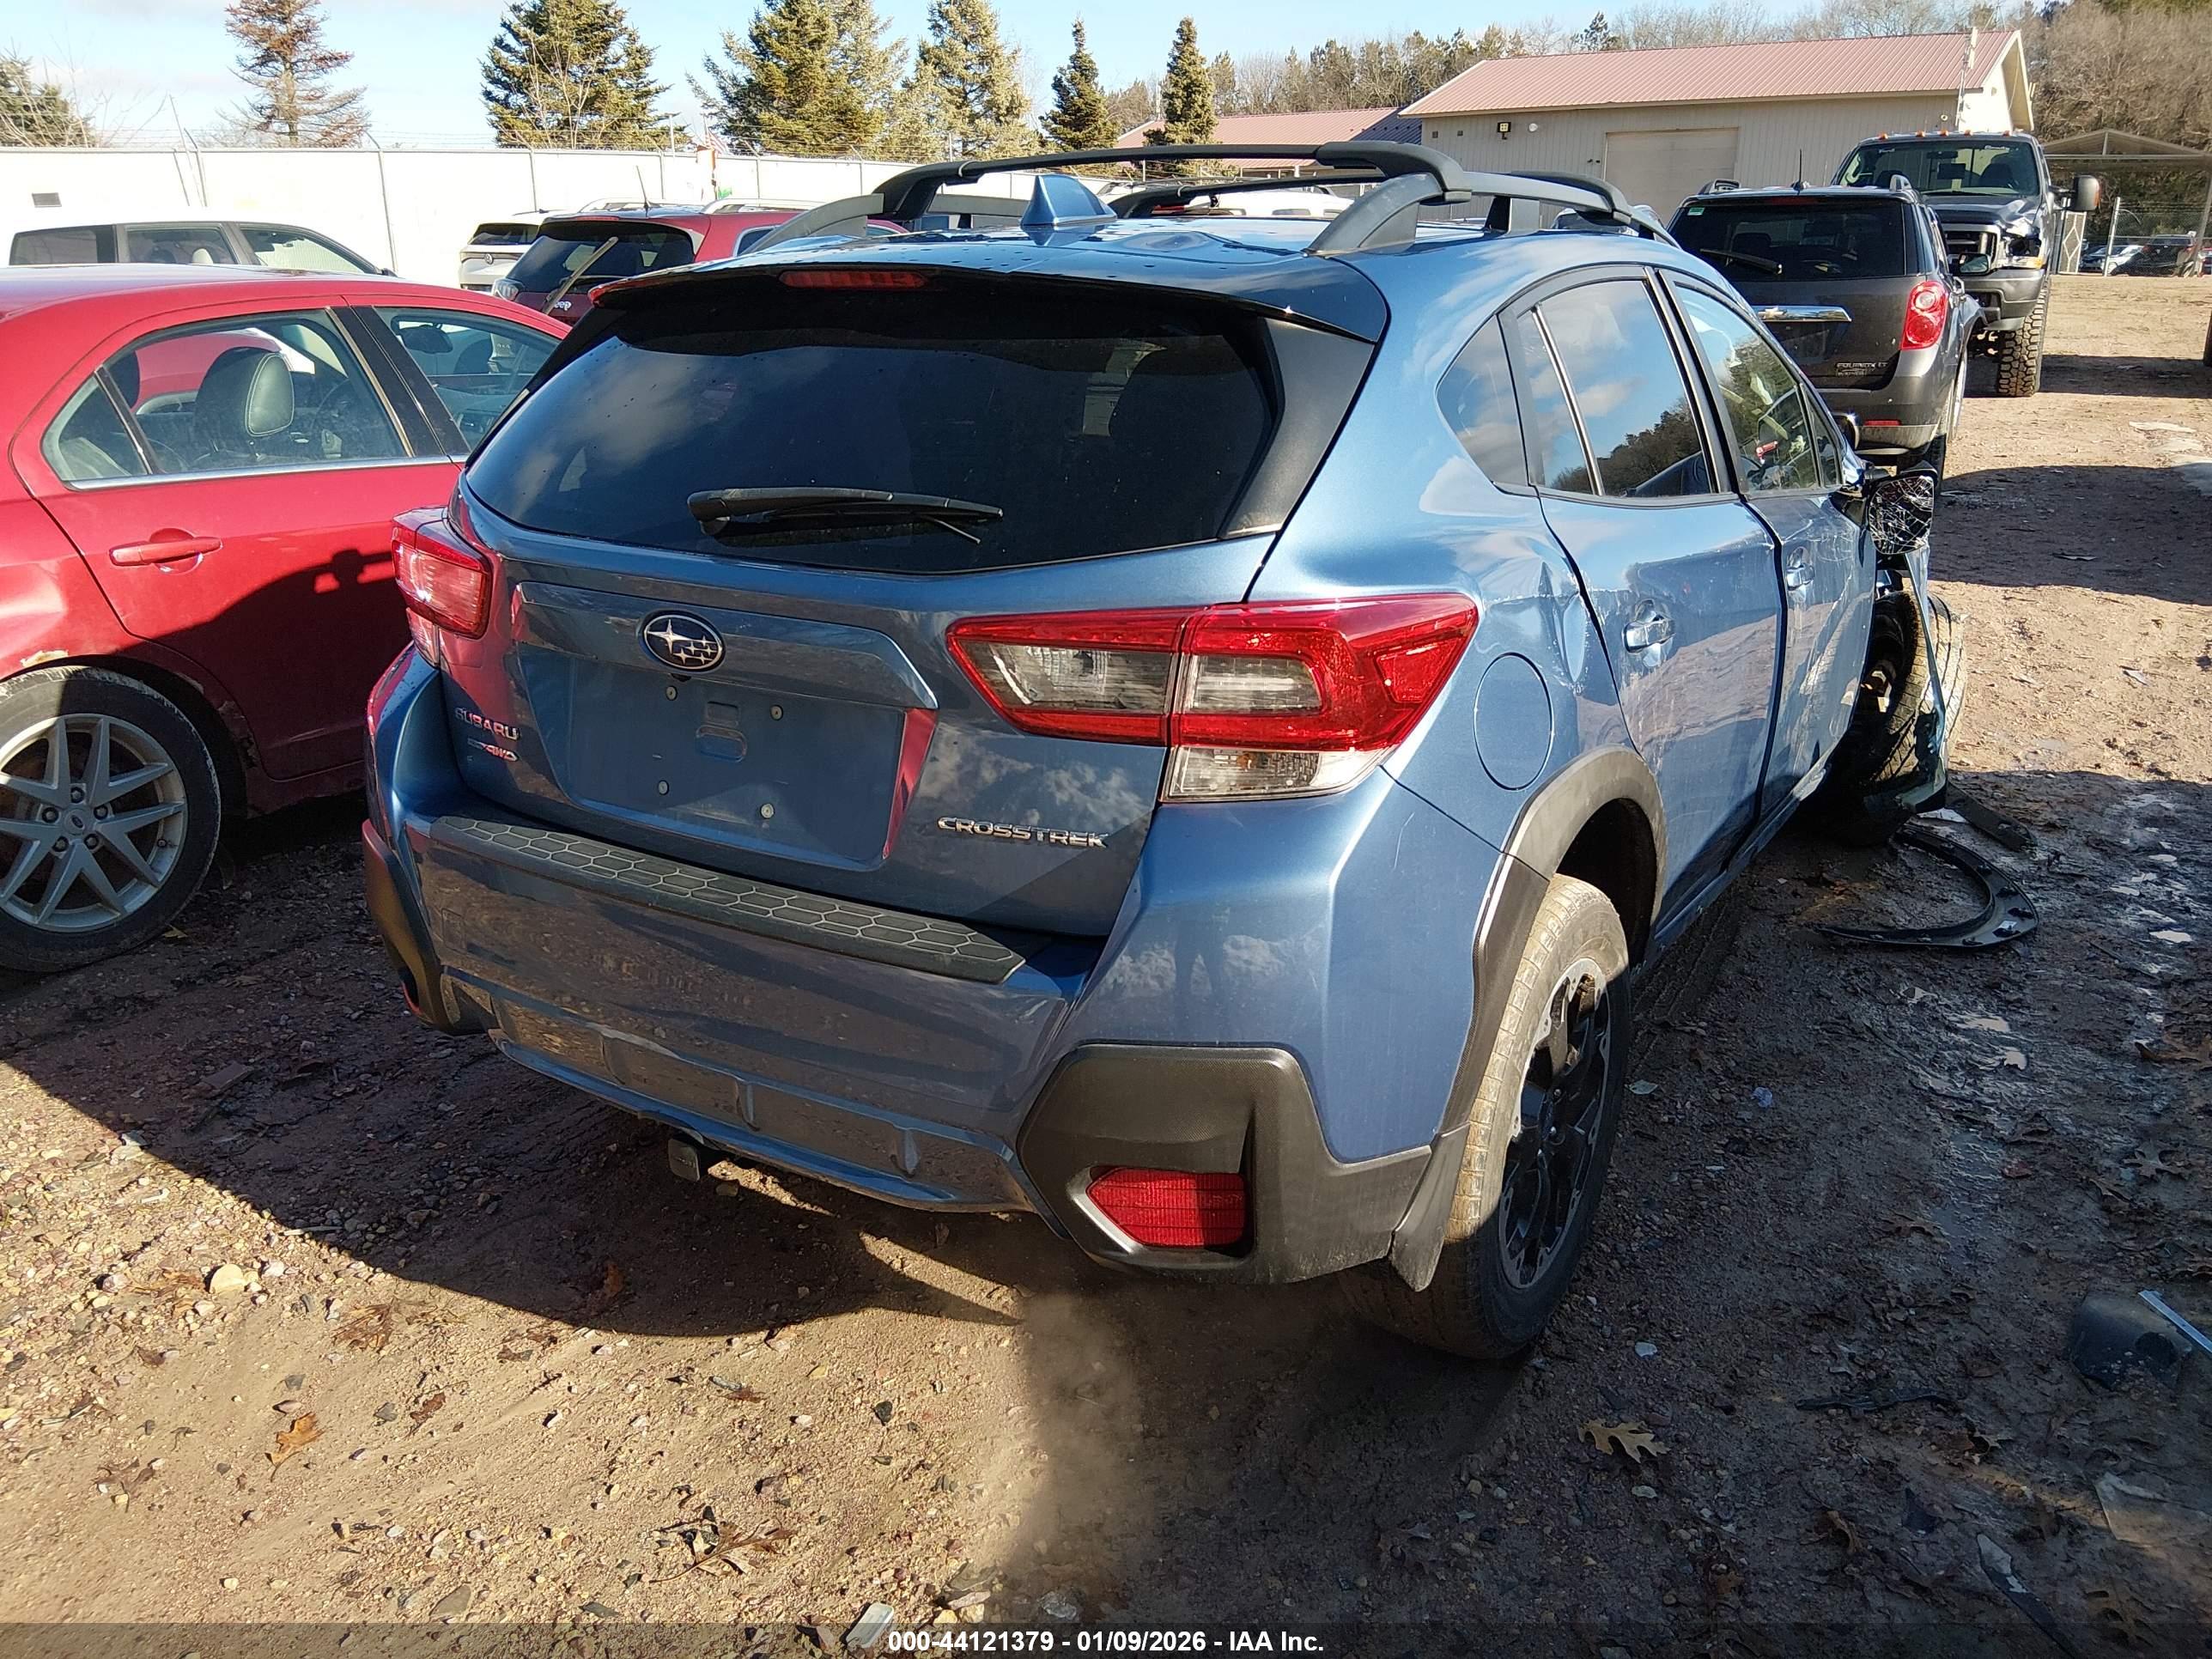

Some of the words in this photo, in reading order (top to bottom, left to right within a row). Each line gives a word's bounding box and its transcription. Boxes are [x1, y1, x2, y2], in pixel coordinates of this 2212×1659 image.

[555, 301, 572, 311] eep
[454, 707, 520, 741] SUBARU
[938, 817, 1109, 848] CROSSTREK
